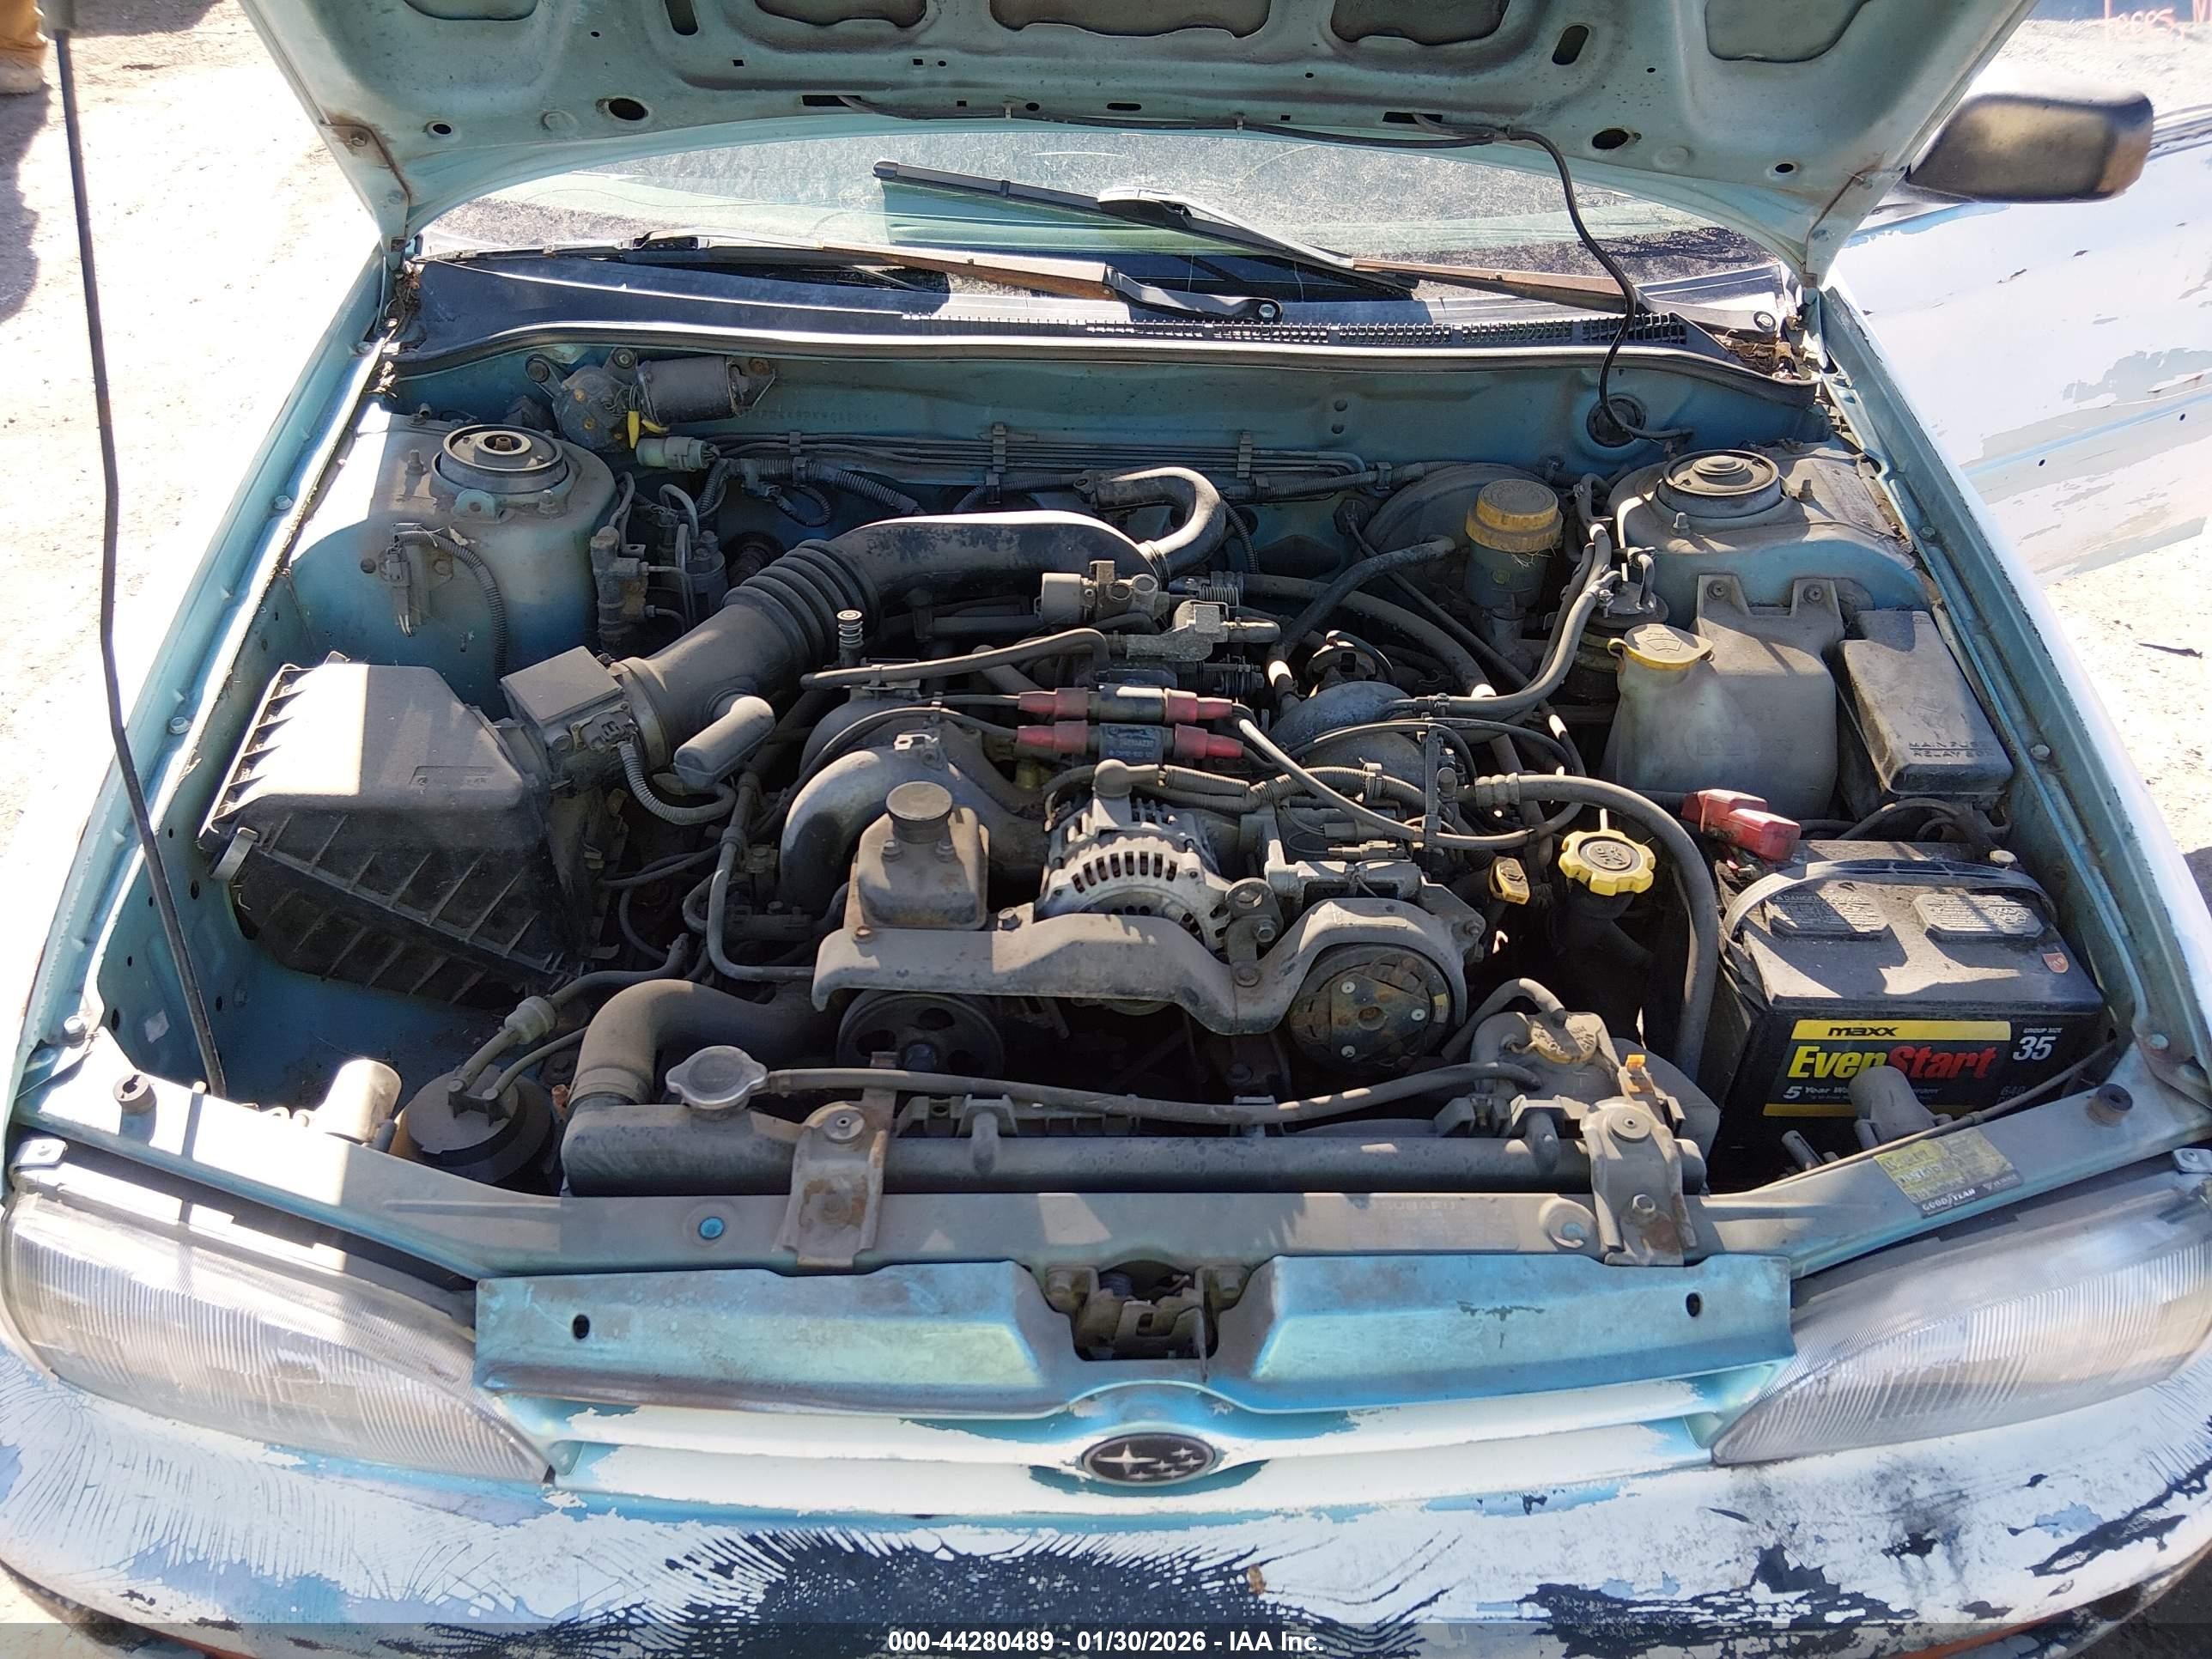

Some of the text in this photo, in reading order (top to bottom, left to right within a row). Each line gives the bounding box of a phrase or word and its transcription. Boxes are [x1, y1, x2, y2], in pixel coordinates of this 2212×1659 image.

[1828, 1026, 1899, 1037] maxx
[2012, 1036, 2057, 1060] 35
[1783, 1085, 1802, 1099] 5
[1805, 1086, 1831, 1095] Year
